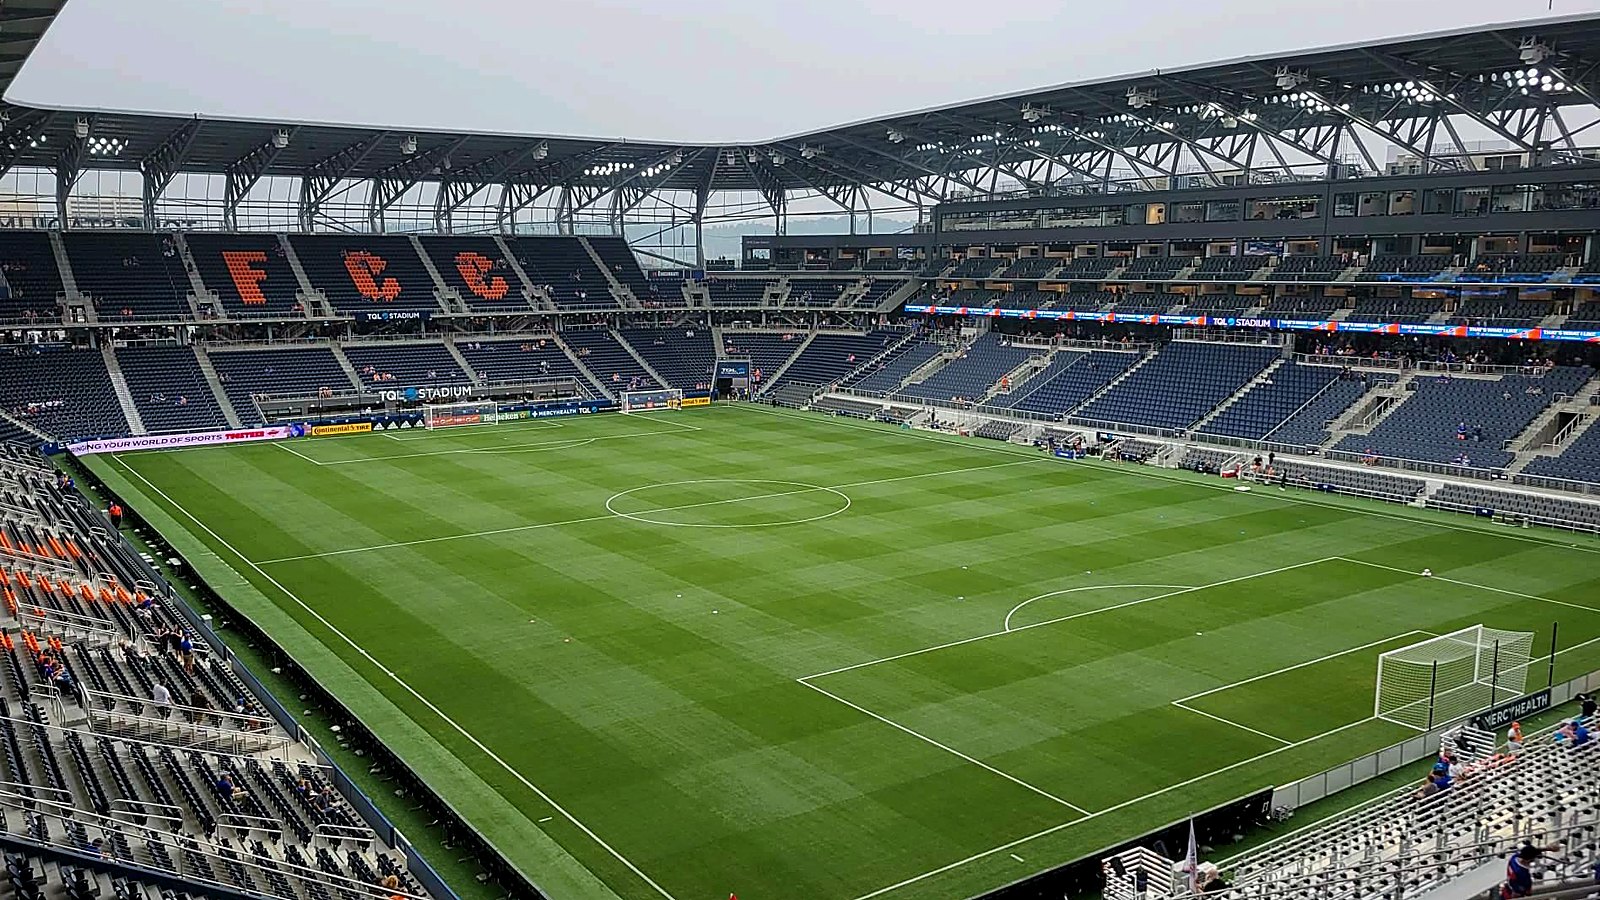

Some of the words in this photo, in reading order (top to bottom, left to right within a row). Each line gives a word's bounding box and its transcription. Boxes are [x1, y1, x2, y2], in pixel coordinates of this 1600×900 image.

[1213, 317, 1227, 326] TQL
[1236, 318, 1270, 328] STADIUM
[380, 390, 405, 400] TQL
[418, 386, 472, 398] STADIUM
[484, 413, 518, 421] Heineken
[314, 426, 350, 434] Continental
[132, 439, 168, 448] WORLD
[185, 434, 222, 442] SPORTS
